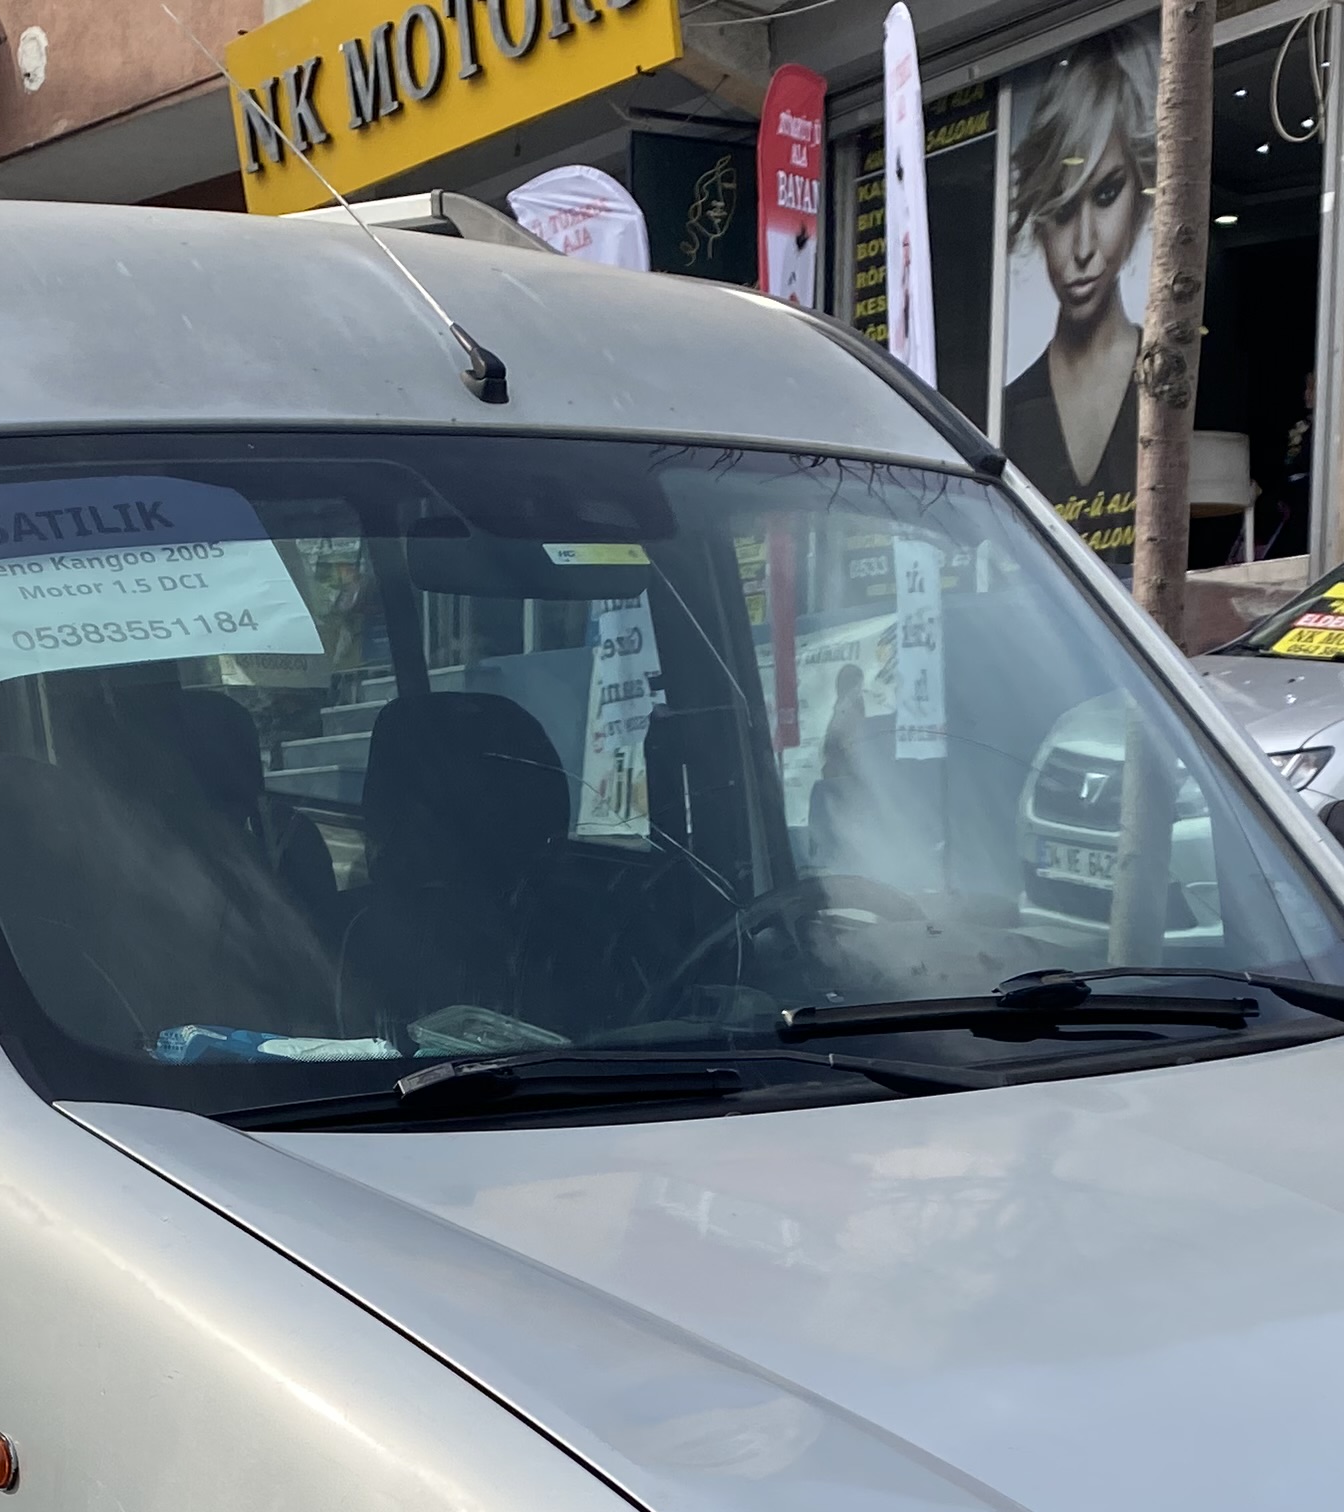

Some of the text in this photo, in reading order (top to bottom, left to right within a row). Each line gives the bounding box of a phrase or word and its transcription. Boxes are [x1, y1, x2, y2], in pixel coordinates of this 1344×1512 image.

[239, 0, 638, 173] NK MOTO
[858, 179, 885, 201] KA
[856, 294, 887, 318] KES
[49, 548, 157, 579] Kangoo
[159, 541, 227, 564] 2005
[18, 571, 210, 602] Motor 1.5 DCI
[12, 607, 261, 653] 05383551184
